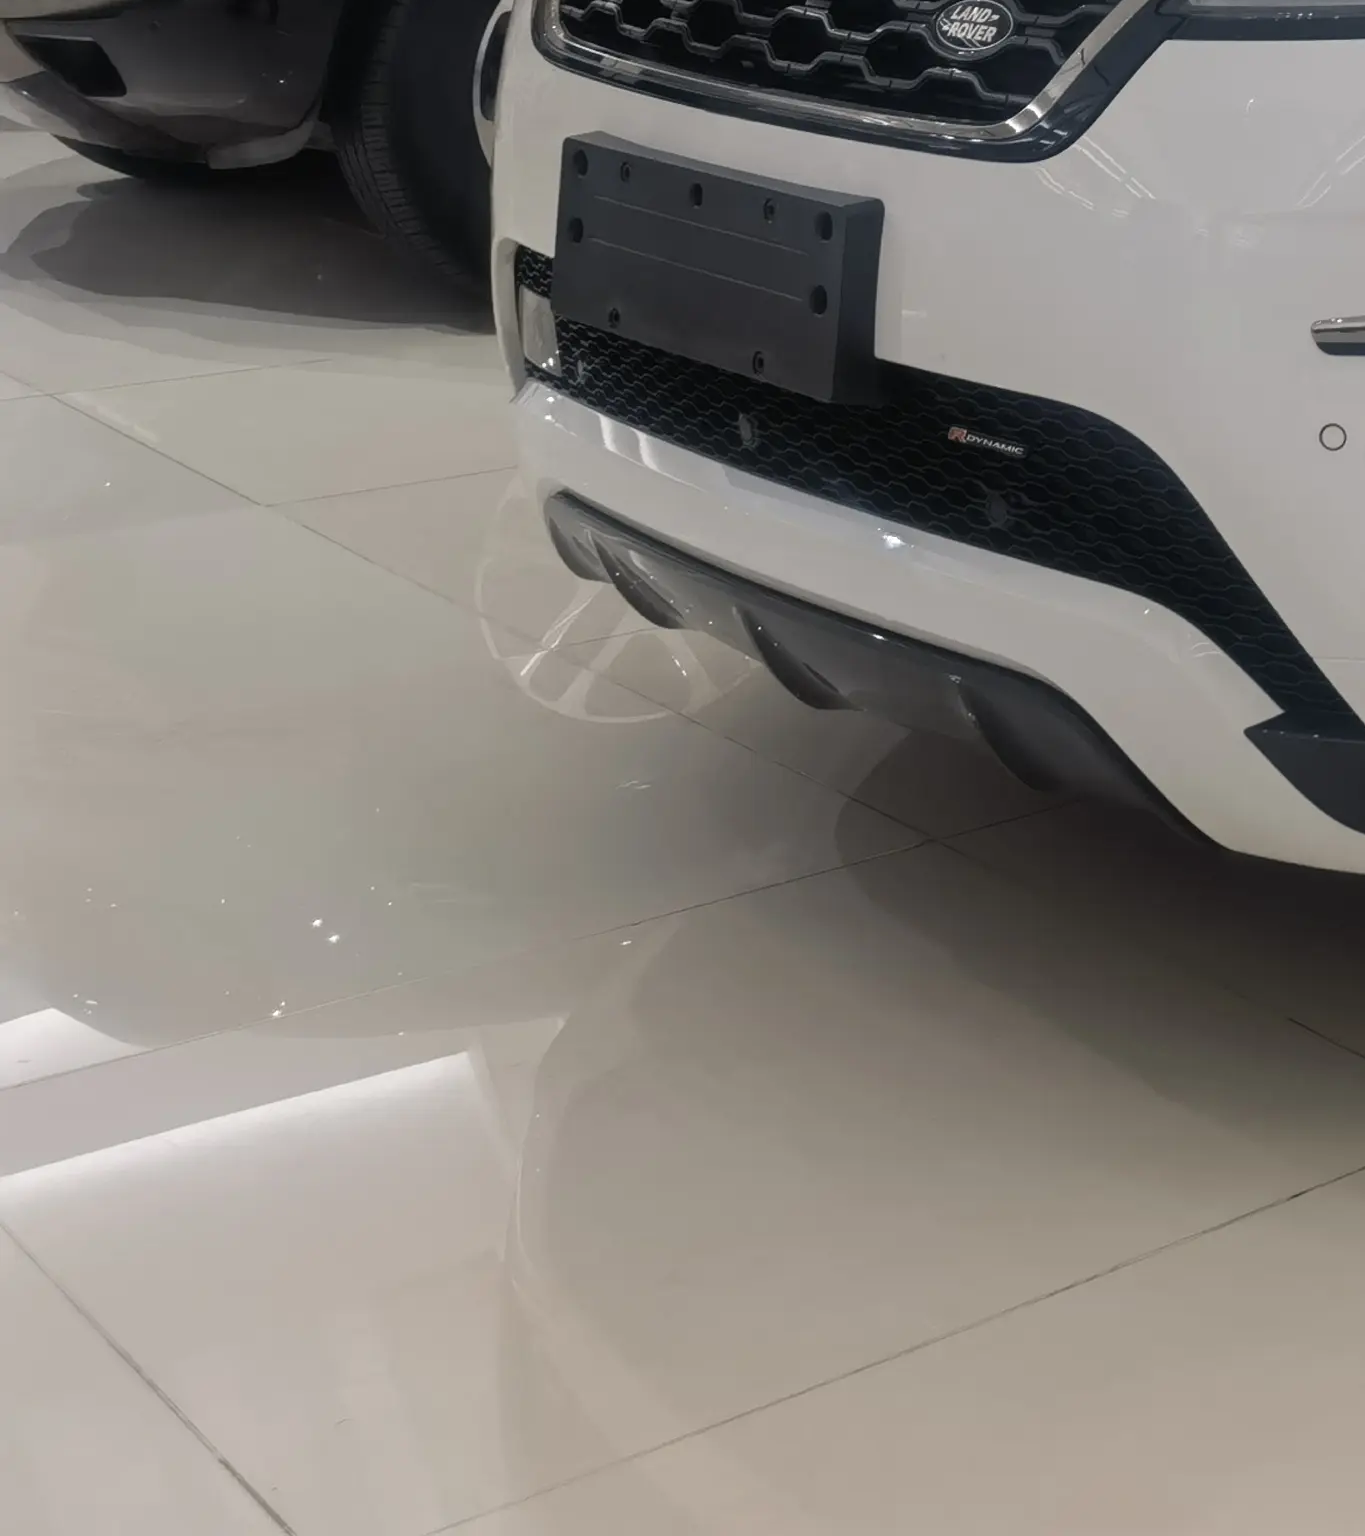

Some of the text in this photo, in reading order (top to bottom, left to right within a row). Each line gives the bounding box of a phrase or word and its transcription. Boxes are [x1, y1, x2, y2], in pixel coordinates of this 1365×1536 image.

[950, 5, 993, 23] LAND
[947, 21, 997, 42] ROVER
[966, 434, 1025, 456] DYNAMIC
